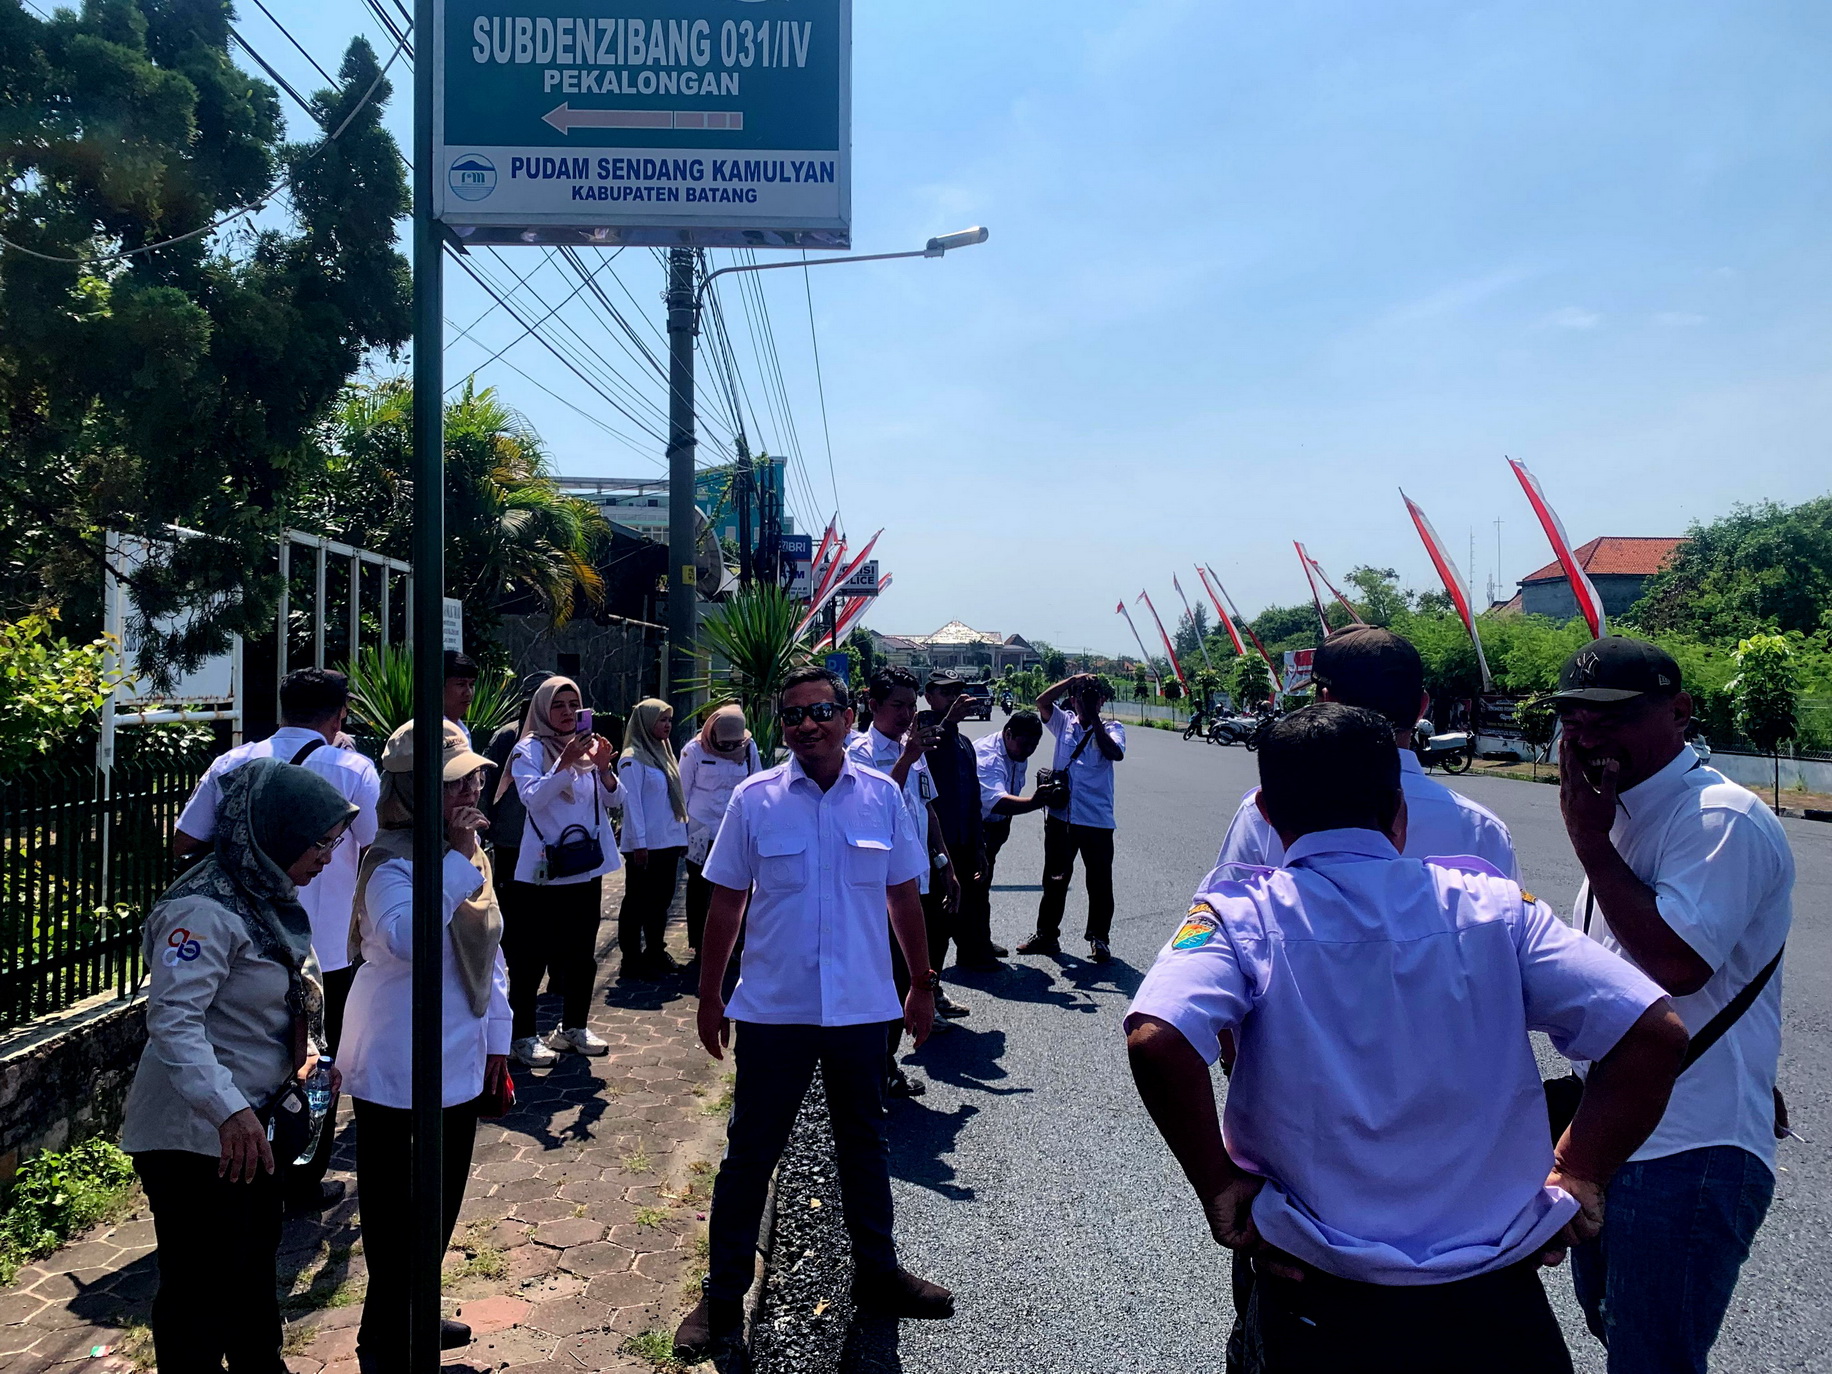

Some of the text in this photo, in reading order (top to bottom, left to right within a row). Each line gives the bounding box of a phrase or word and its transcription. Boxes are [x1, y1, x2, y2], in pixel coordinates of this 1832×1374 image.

[472, 15, 812, 68] SUBDENZIBANG 031/IV
[543, 69, 740, 96] PEKALONGAN
[511, 156, 836, 184] PUDAM SENDANG KAMULYAN
[572, 185, 758, 204] KABUPATEN BATANG
[788, 541, 806, 553] BRI
